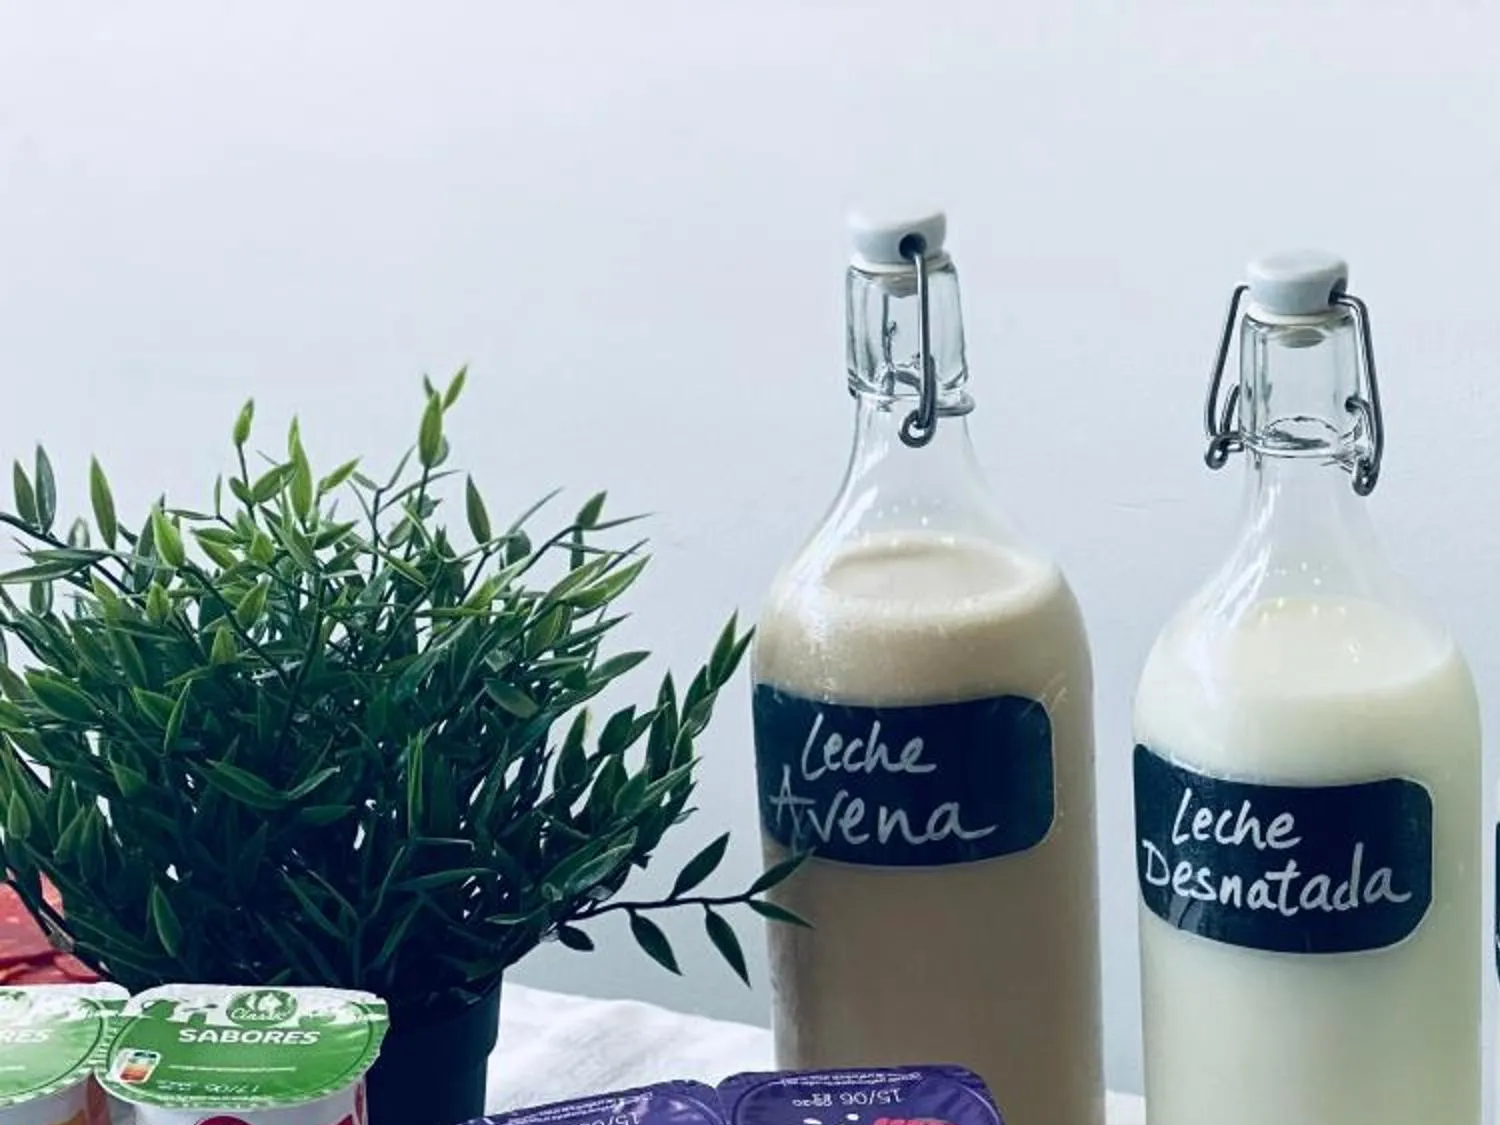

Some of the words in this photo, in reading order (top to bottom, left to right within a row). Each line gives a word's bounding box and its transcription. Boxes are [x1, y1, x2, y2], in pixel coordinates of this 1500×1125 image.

[802, 712, 936, 783] Leche
[770, 767, 996, 845] Avena
[1172, 789, 1300, 849] Leche
[1142, 842, 1412, 915] Desnatada
[178, 1028, 321, 1045] SABORES
[840, 1088, 902, 1106] 15/06
